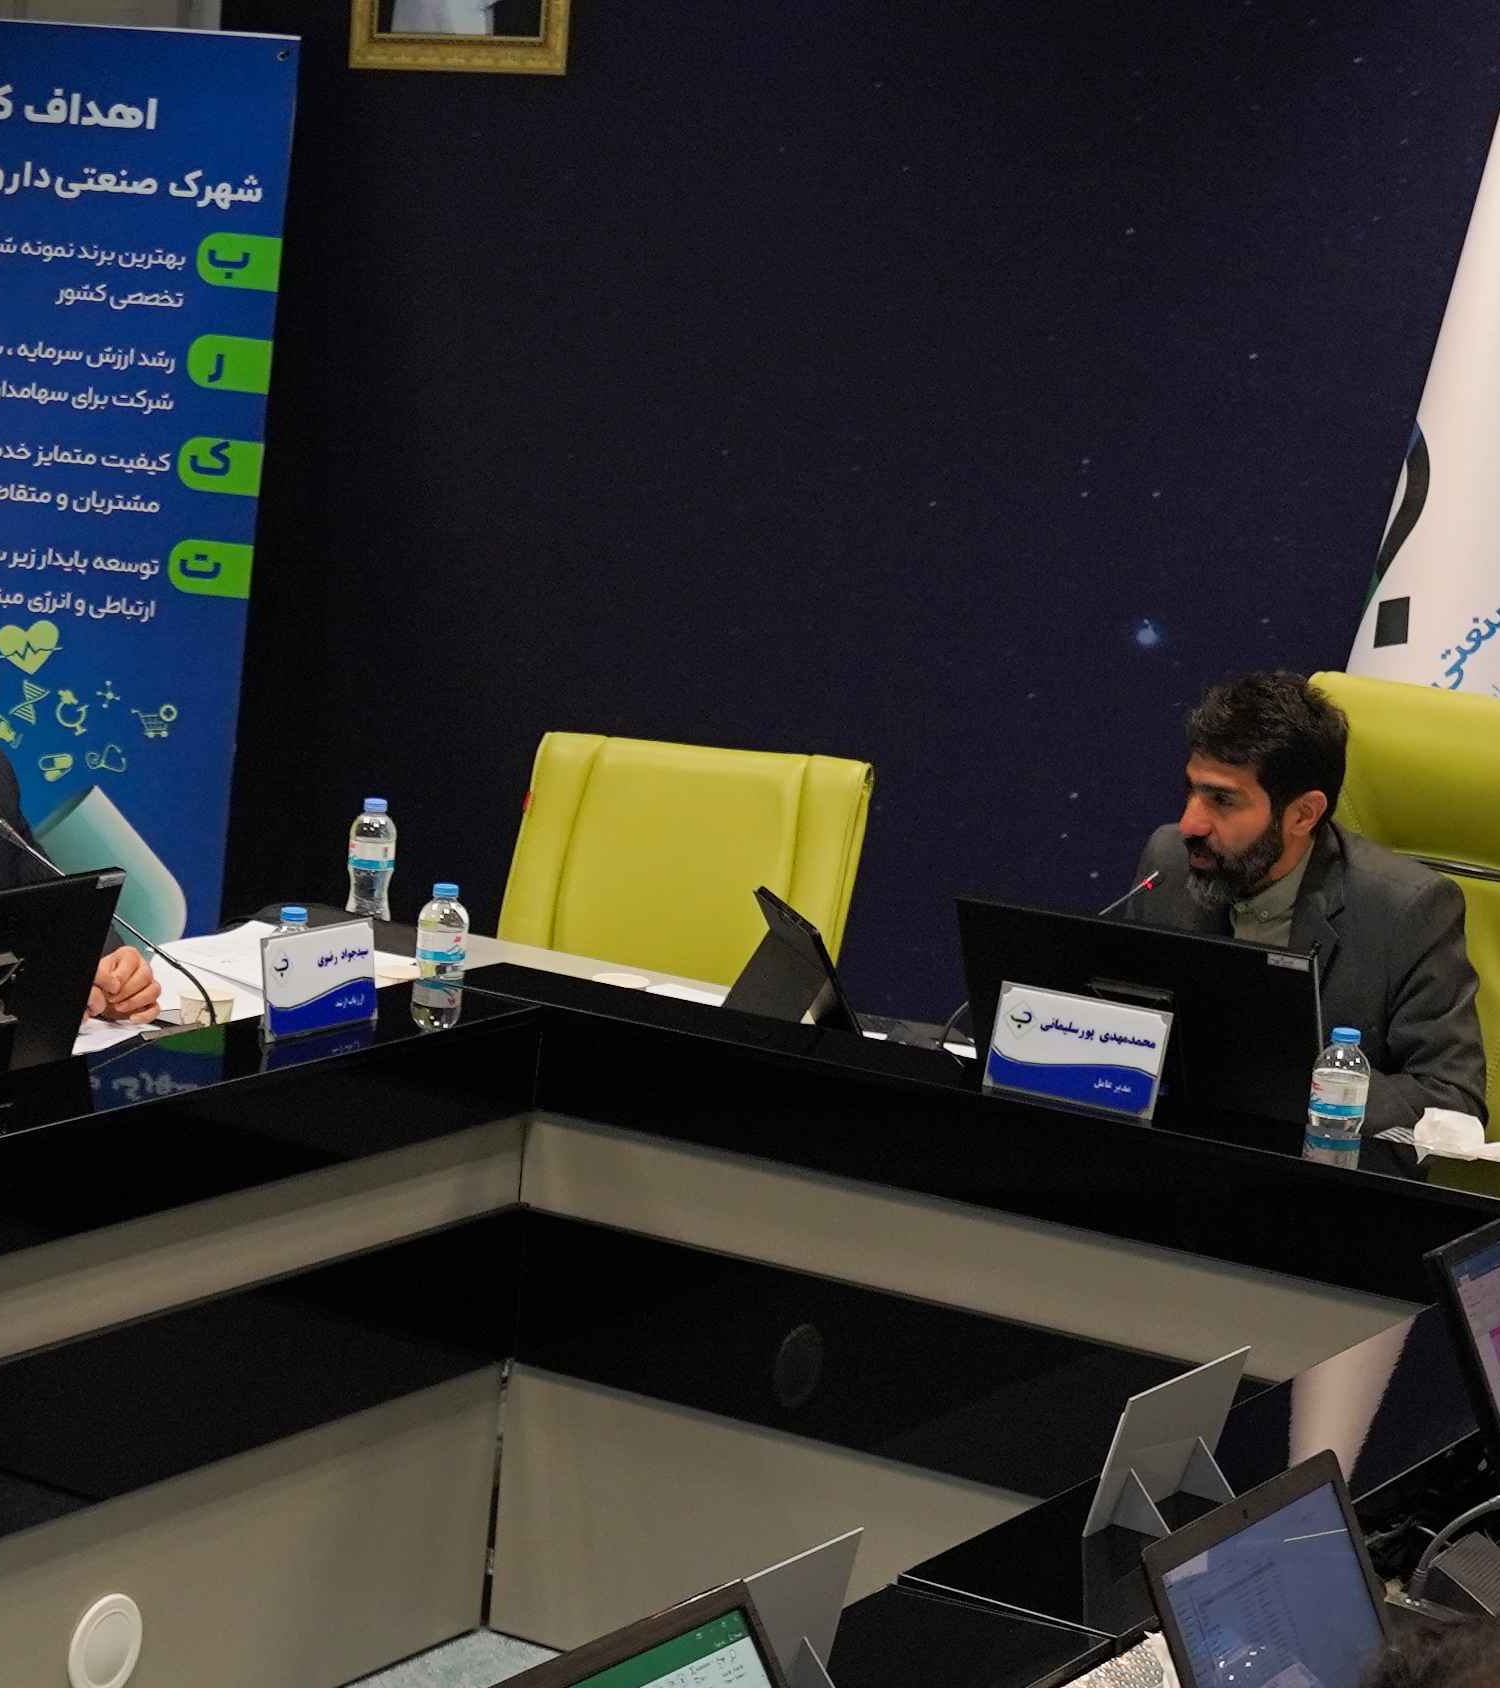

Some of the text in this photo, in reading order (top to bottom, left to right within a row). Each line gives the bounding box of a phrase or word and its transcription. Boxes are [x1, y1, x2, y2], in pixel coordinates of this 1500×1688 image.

[25, 89, 157, 129] اهداف
[55, 168, 157, 198] صنعتی
[169, 170, 262, 209] شهرک
[21, 242, 74, 262] نمونه
[78, 246, 115, 266] برند
[118, 250, 185, 270] بهترین
[209, 248, 250, 279] ب
[55, 284, 183, 309] تخصصی کشور
[17, 342, 83, 365] سرمایه
[87, 347, 134, 370] ارزش
[138, 352, 175, 374] رشد
[209, 353, 224, 382] ر
[72, 387, 108, 410] برای
[112, 390, 173, 414] شرکت
[34, 446, 96, 466] متمایز
[101, 454, 170, 475] کیفیت
[190, 441, 231, 478] ک
[57, 494, 68, 510] و
[73, 491, 159, 514] مشتریان
[11, 549, 35, 569] زیر
[37, 548, 88, 574] پایدار
[94, 557, 159, 580] توسعه
[179, 553, 221, 580] ت
[28, 592, 71, 613] انرژی
[75, 599, 85, 616] و
[89, 596, 155, 622] ارتباطی
